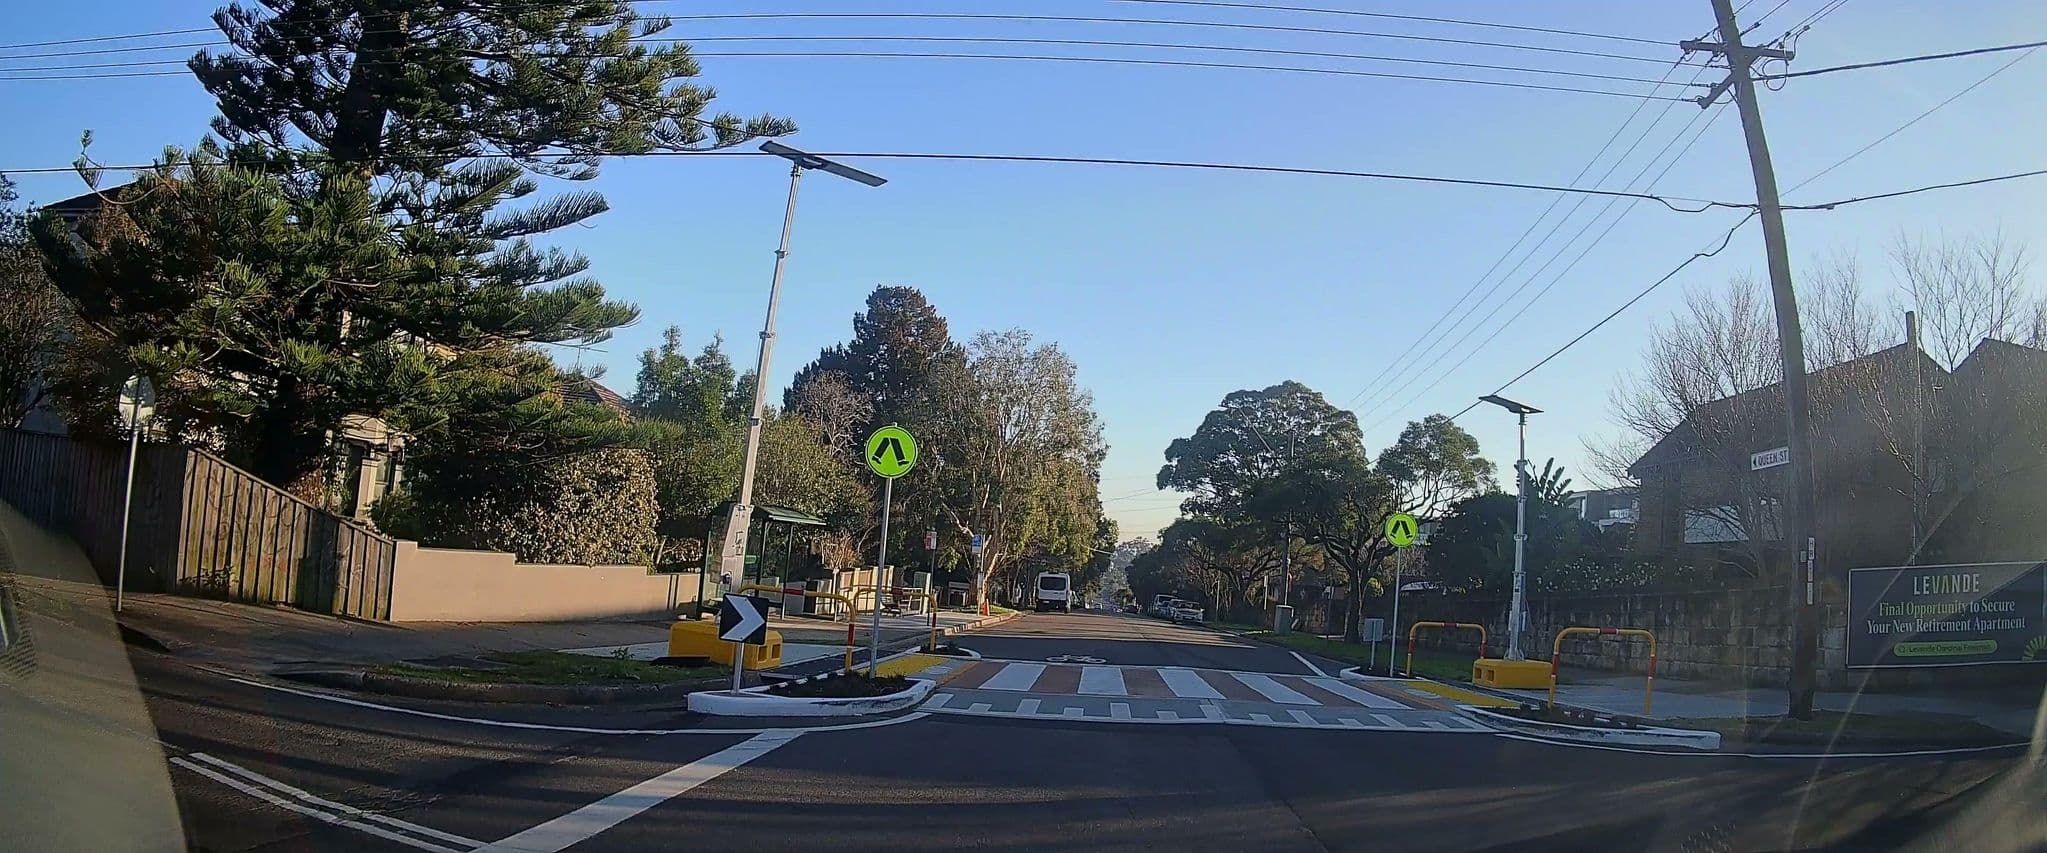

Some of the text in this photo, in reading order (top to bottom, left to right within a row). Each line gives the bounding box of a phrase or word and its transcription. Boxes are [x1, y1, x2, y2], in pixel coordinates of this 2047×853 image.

[1758, 450, 1787, 466] QUEEN ST
[1913, 573, 1980, 595] LEVANDE
[1879, 599, 2015, 618] Final Opportunity to Secure
[1867, 616, 2025, 634] Your New Retirement Apartment
